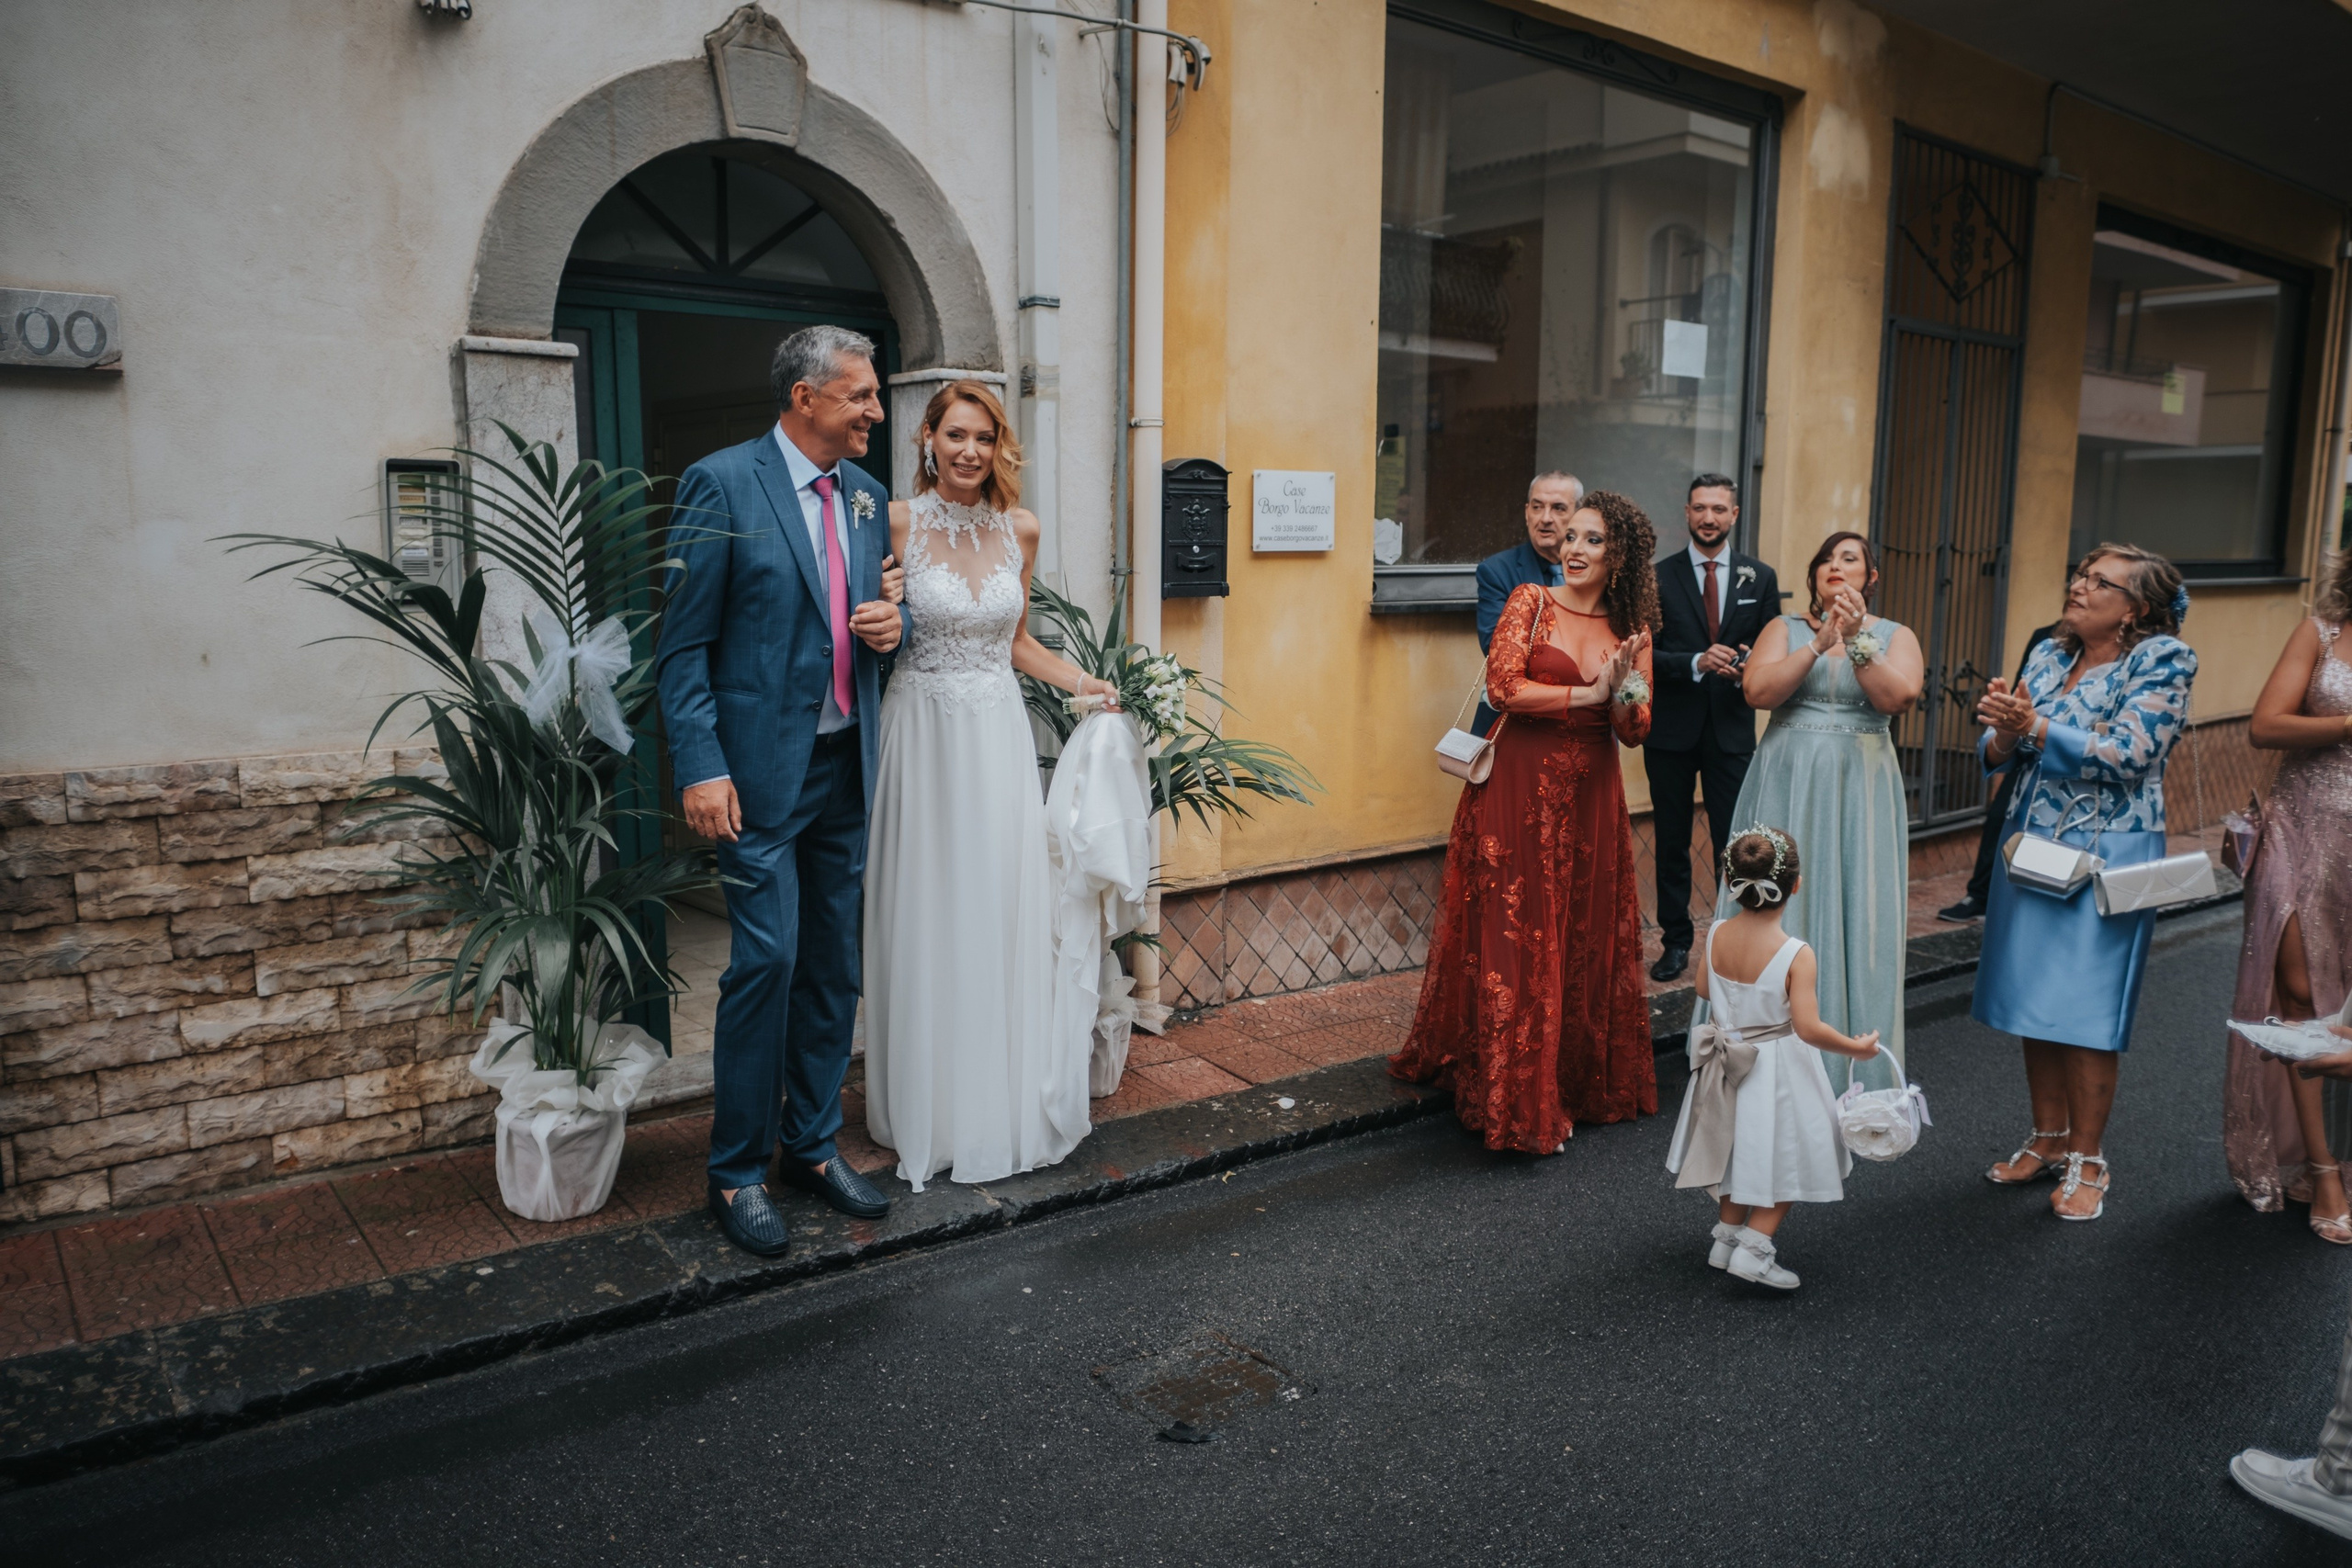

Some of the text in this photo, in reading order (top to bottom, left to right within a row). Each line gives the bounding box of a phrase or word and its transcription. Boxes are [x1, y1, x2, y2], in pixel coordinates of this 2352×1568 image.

[0, 306, 107, 358] 00
[1283, 479, 1306, 497] Case
[1258, 497, 1330, 517] Borgo Vacanze
